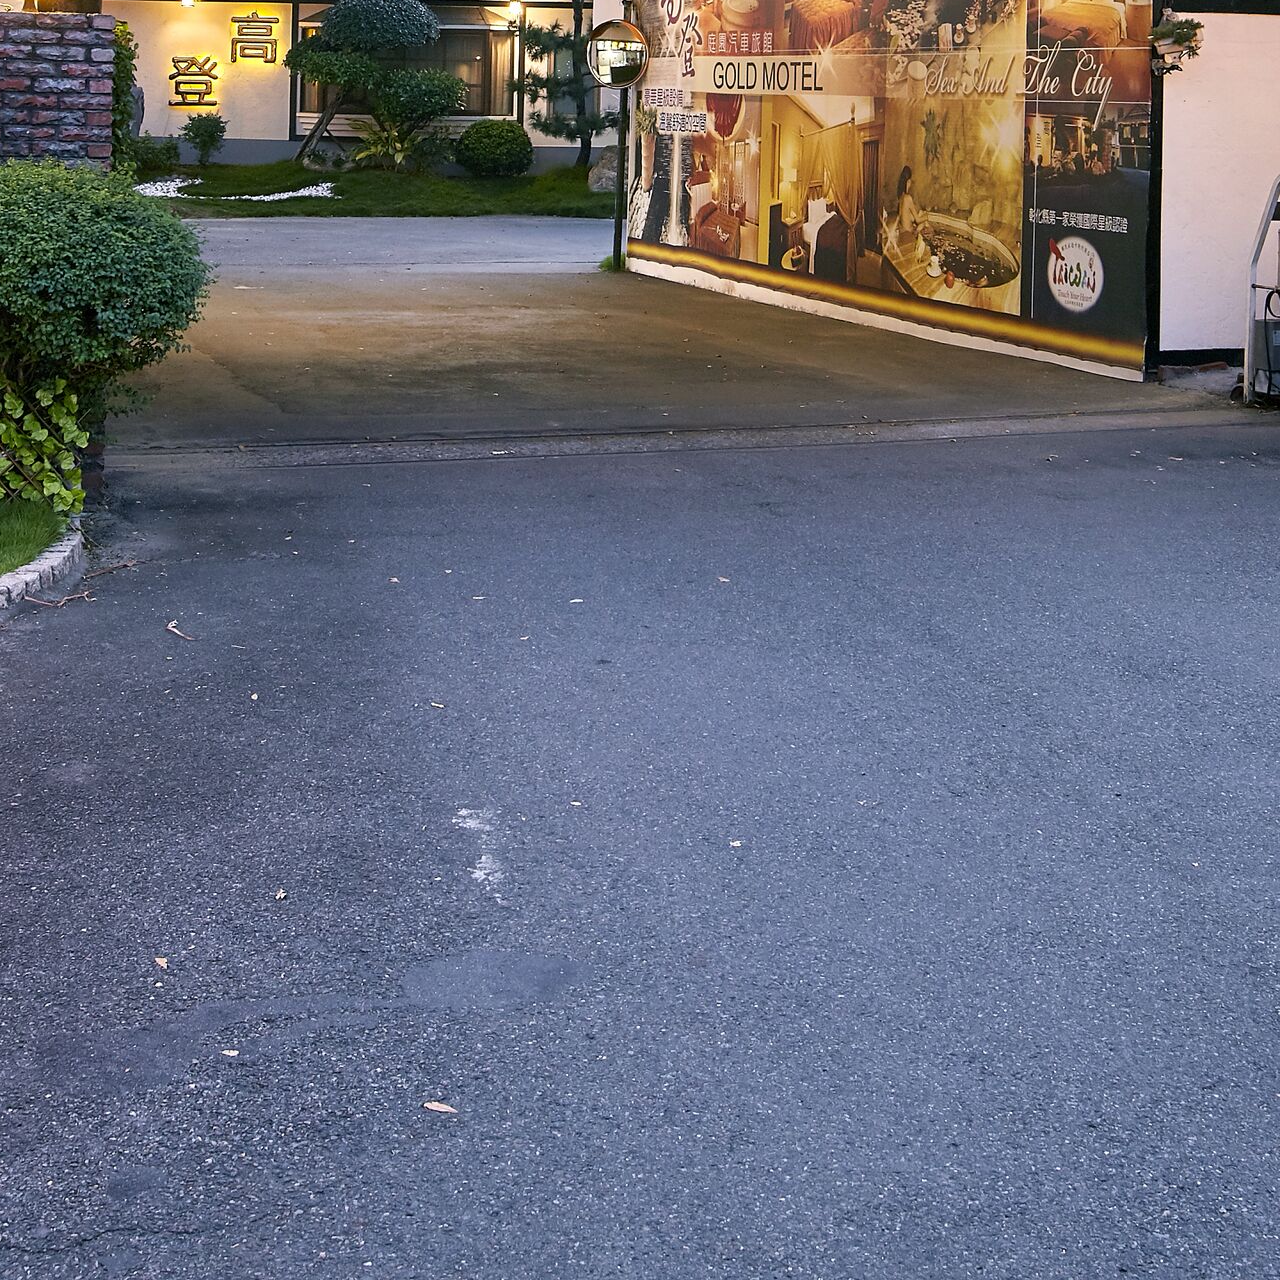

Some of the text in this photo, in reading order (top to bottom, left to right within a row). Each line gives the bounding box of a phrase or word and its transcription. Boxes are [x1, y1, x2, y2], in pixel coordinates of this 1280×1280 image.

[712, 61, 824, 91] GOLD MOTEL
[960, 56, 1016, 94] And
[1019, 40, 1061, 94] The
[1071, 49, 1113, 132] City
